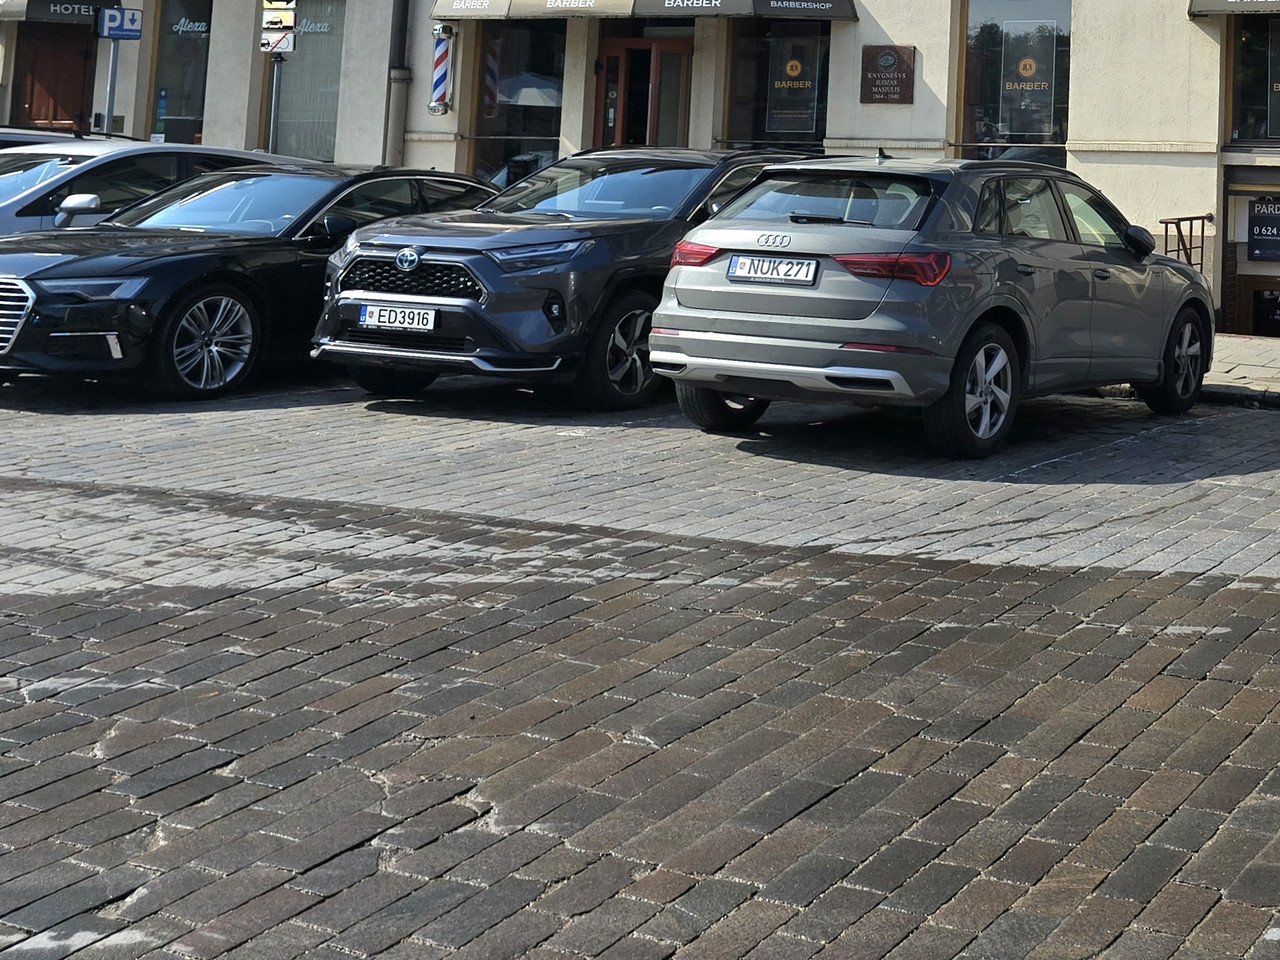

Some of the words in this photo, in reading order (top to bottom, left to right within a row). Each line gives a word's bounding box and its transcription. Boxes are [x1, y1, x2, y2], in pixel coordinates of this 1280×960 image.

[50, 3, 95, 16] HOTEL
[452, 0, 490, 9] BARBER
[546, 0, 595, 8] BARBER
[770, 0, 833, 10] BARBERSHOP
[103, 9, 121, 36] P
[172, 17, 208, 34] Alexa
[294, 18, 330, 33] Alexa
[1005, 82, 1049, 90] BARBER
[1261, 227, 1277, 235] 624
[747, 258, 783, 277] NUK
[783, 260, 812, 278] 271
[377, 308, 429, 327] ED3916
